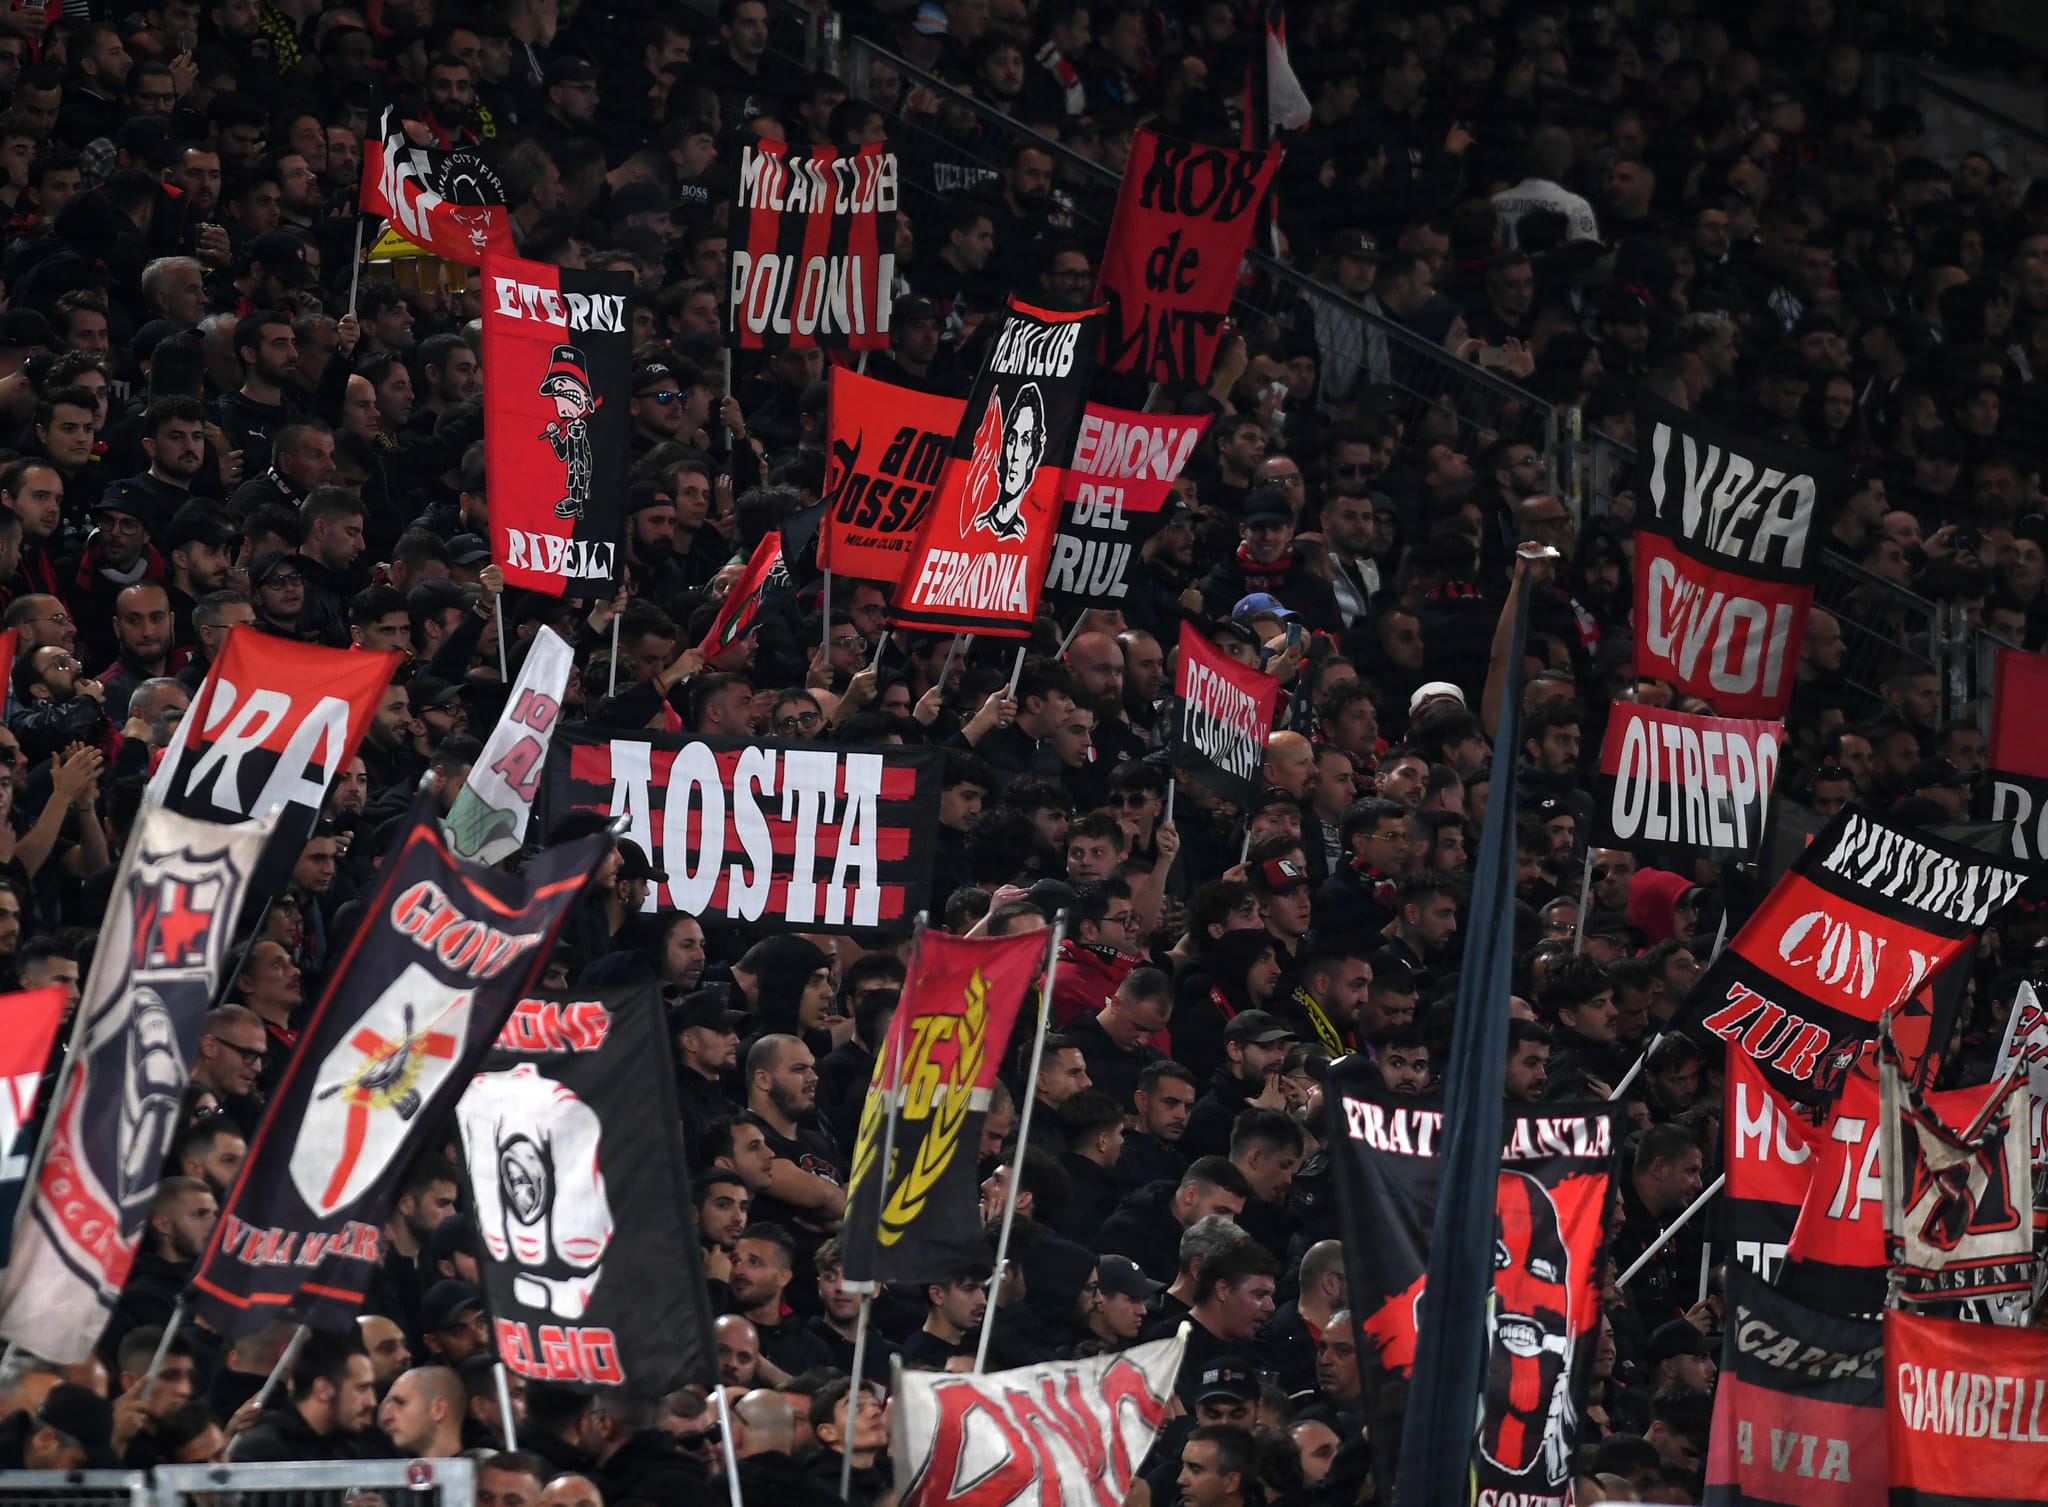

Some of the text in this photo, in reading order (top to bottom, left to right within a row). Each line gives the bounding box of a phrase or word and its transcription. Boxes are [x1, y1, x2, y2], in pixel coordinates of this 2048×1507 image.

[452, 153, 481, 167] CITY
[681, 184, 708, 200] BOSS
[738, 146, 898, 216] MILAN CLUB
[1139, 135, 1267, 222] ROB
[1146, 229, 1199, 294] de
[492, 276, 627, 333] ETERNI
[1026, 322, 1082, 378] CLUB
[1071, 483, 1129, 532] DEL
[1650, 421, 1816, 568] IVREA
[505, 527, 615, 581] RIBELLI
[845, 533, 876, 549] MILAN
[877, 537, 902, 551] CLUB
[1044, 533, 1132, 599] RIUL
[911, 548, 1028, 615] FERRANDINA
[1611, 715, 1778, 849] OLTREPO
[609, 738, 884, 927] AOSTA
[1778, 910, 1888, 1000] CON
[1898, 1362, 2048, 1443] GIAMBELL
[1770, 1428, 1851, 1483] VIA
